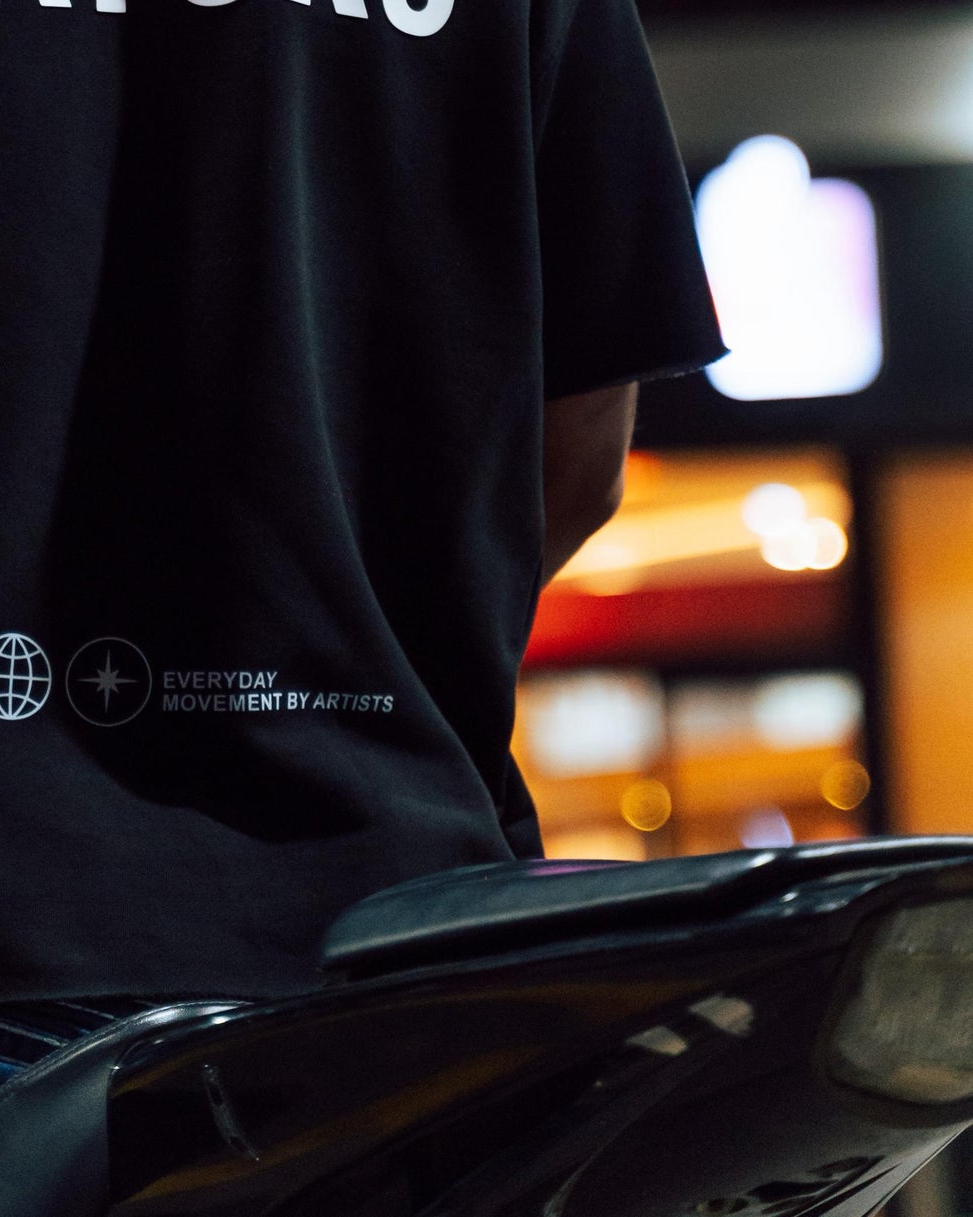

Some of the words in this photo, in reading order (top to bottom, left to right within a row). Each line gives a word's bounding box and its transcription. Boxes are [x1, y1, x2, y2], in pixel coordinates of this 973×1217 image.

[163, 671, 278, 690] EVERYDAY
[162, 692, 283, 712] MOVEMENT
[287, 692, 311, 711] BY
[313, 692, 394, 713] ARTISTS
